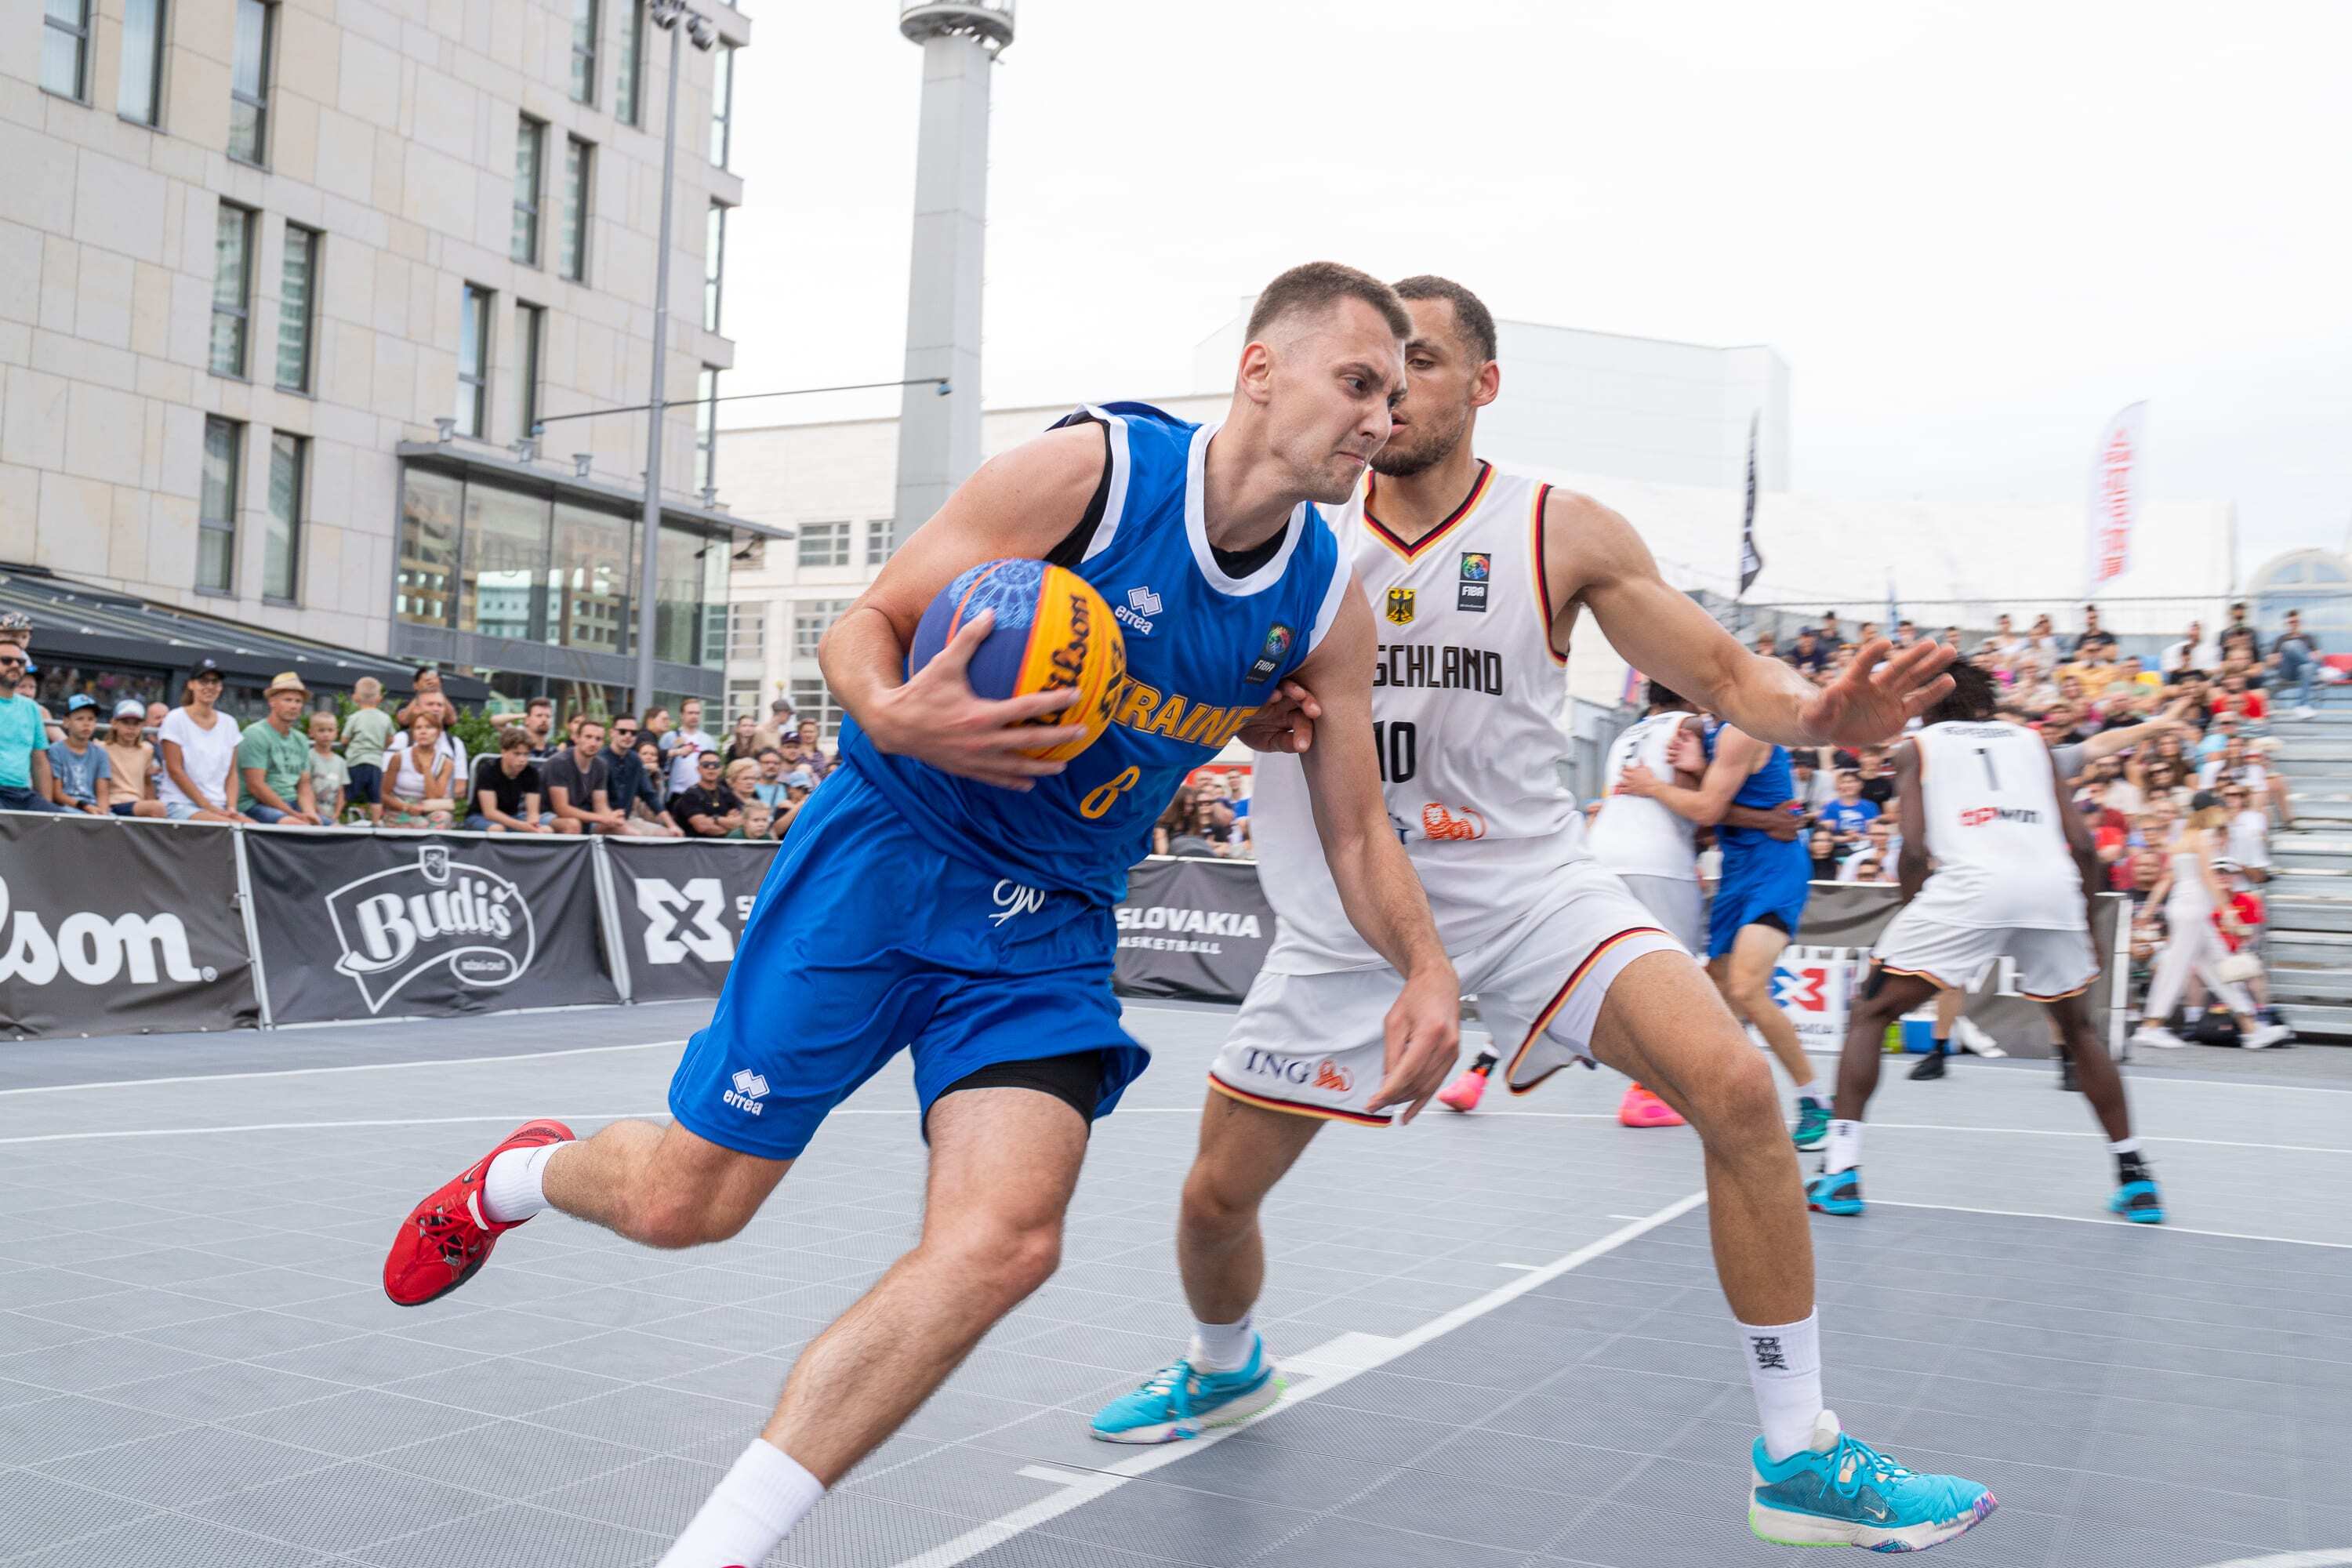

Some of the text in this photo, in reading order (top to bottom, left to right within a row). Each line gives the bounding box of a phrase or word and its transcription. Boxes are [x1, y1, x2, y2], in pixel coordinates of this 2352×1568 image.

[1461, 586, 1485, 597] FIBA
[1114, 604, 1154, 635] errea
[1254, 659, 1276, 672] FIBA
[343, 876, 512, 975] Budiš
[1115, 906, 1262, 938] SLOVAKIA
[1243, 1047, 1312, 1084] ING
[723, 1089, 764, 1116] errea
